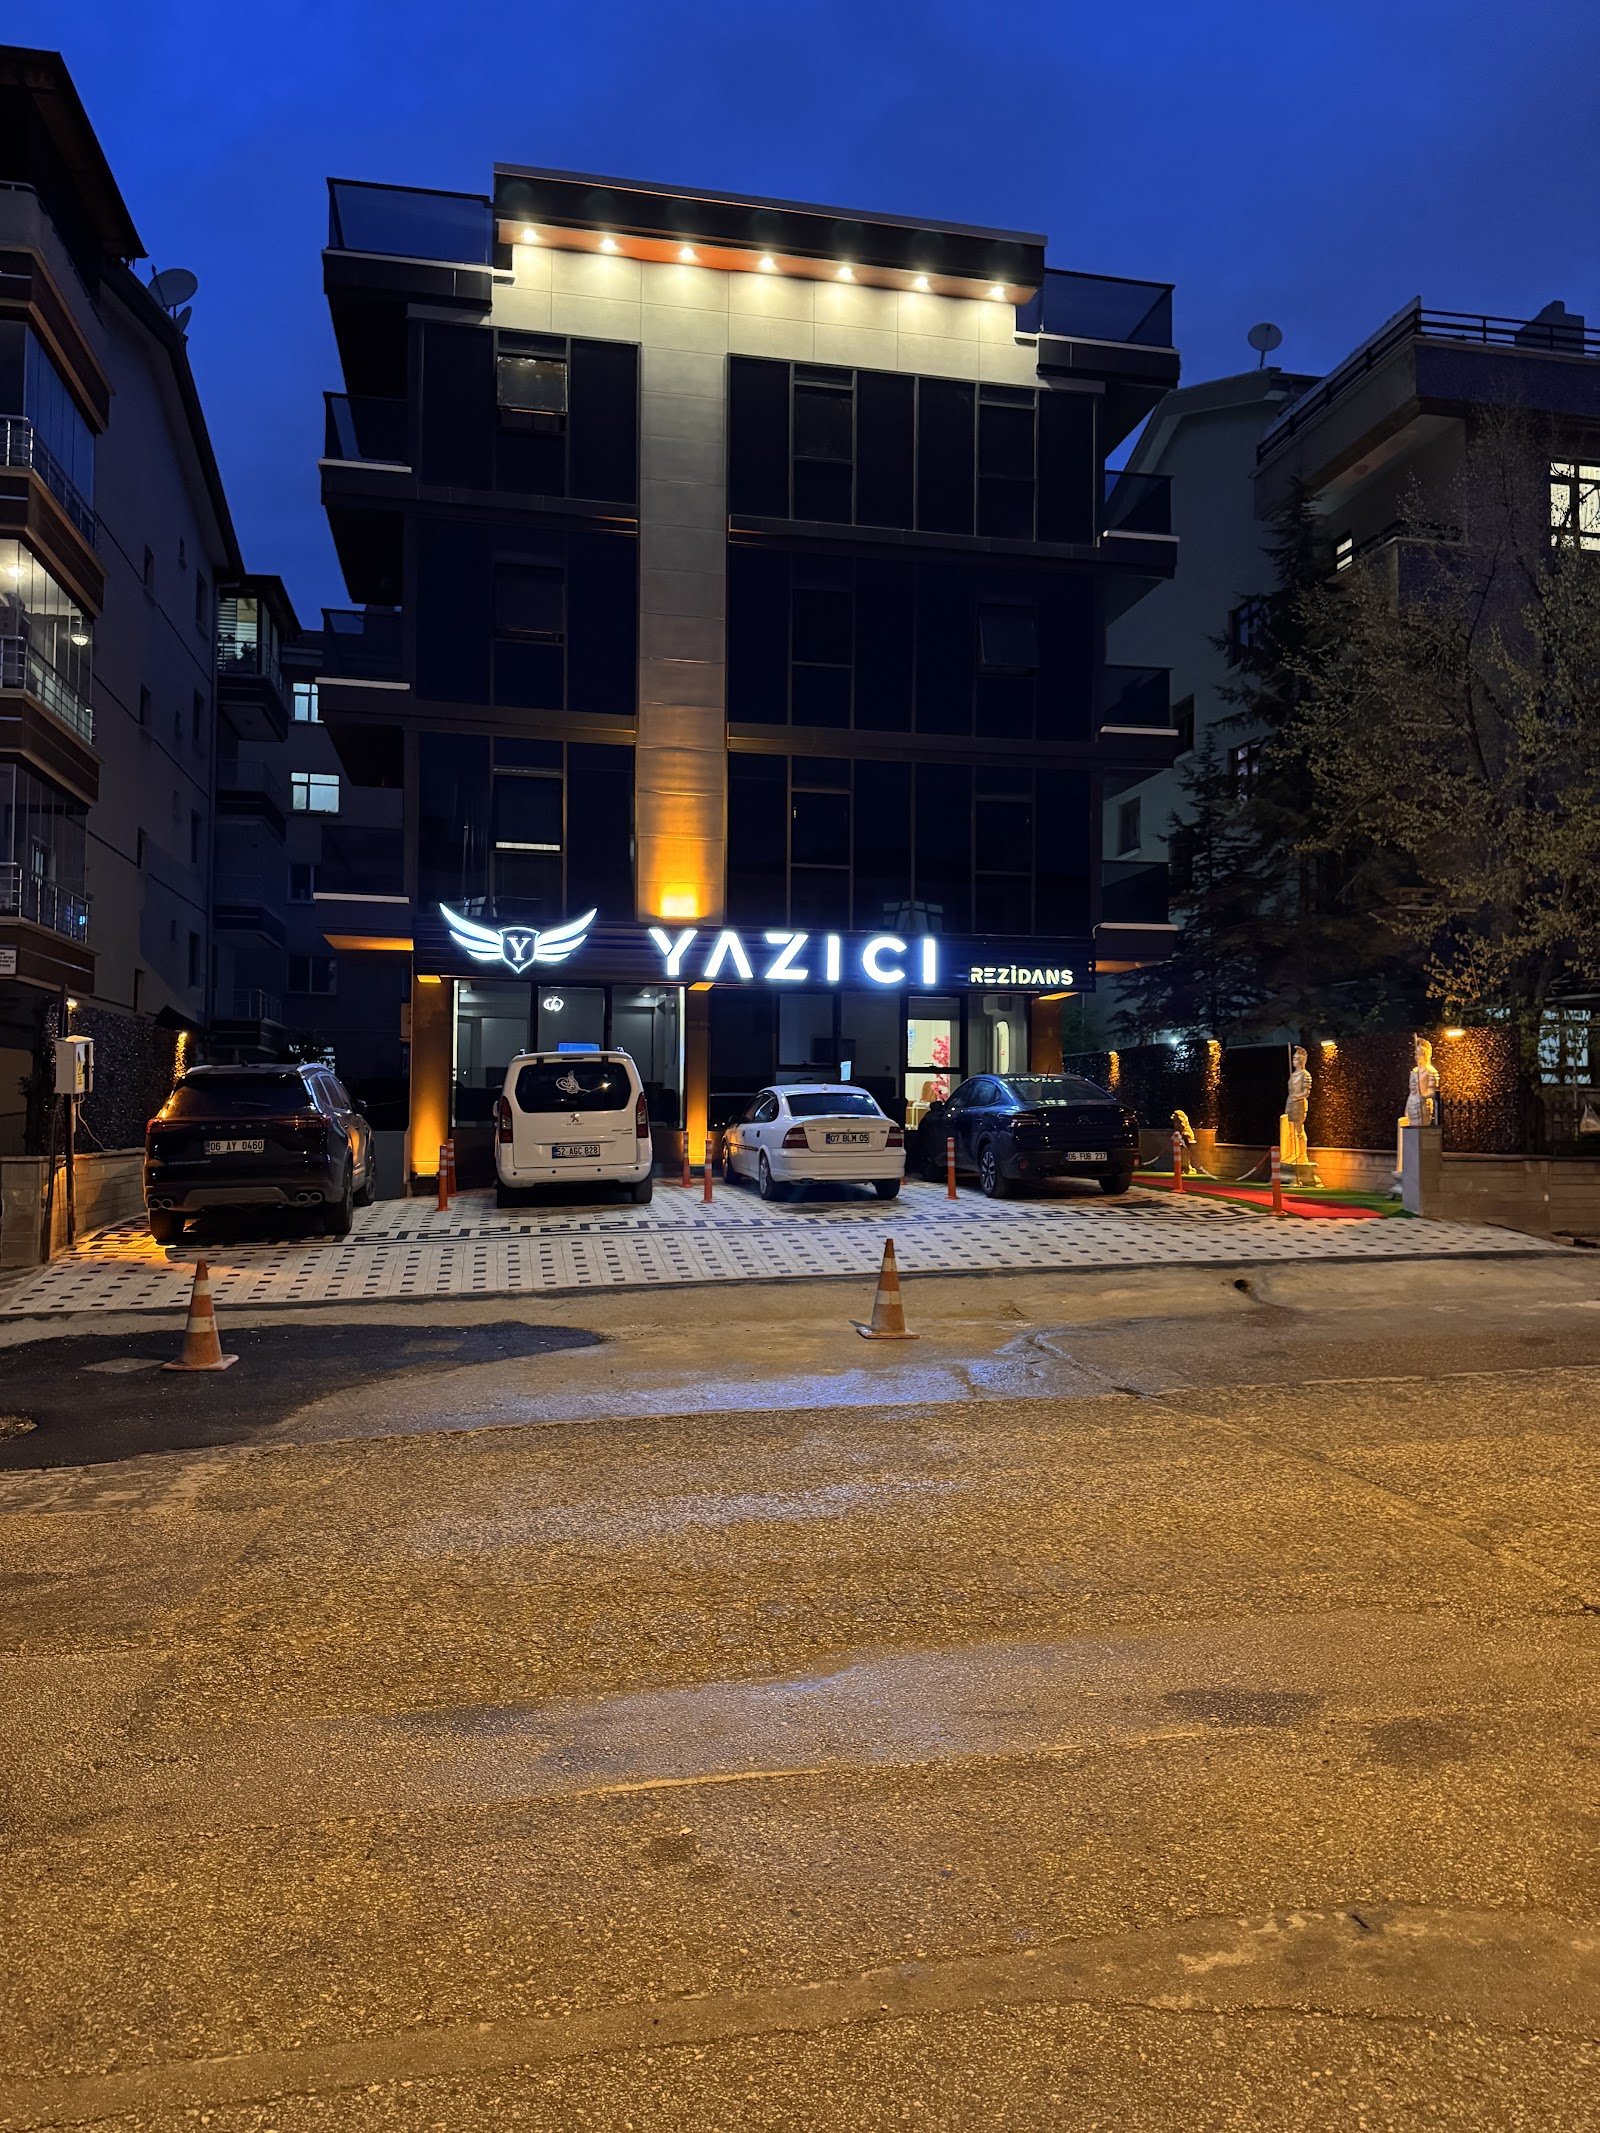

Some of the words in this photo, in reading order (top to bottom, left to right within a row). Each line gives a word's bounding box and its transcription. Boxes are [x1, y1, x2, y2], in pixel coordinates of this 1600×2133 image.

[506, 936, 532, 961] Y
[649, 928, 936, 985] YAZICI
[970, 964, 1074, 986] REZİDANS
[210, 1142, 221, 1151] 06
[226, 1141, 237, 1151] AY
[242, 1140, 263, 1150] 0460
[831, 1135, 840, 1143] 07
